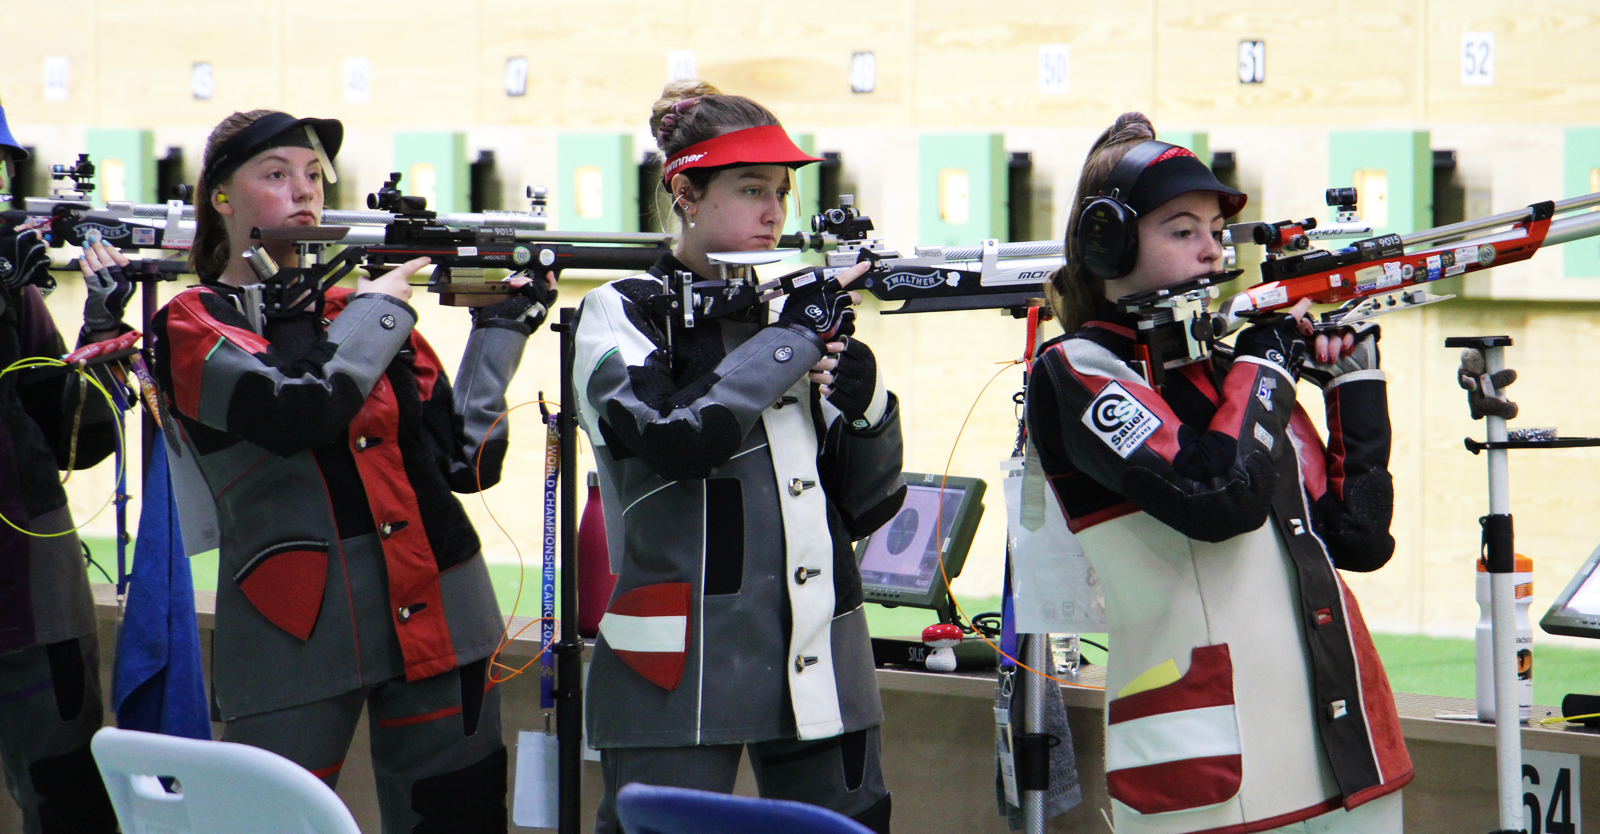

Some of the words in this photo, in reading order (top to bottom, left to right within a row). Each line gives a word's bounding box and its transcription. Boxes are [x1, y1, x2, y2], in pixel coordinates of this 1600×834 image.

[849, 54, 876, 90] 49
[1044, 53, 1065, 86] 50
[1239, 41, 1264, 83] 51
[1464, 41, 1490, 76] 52
[192, 64, 213, 98] 45
[666, 154, 704, 174] winner
[494, 228, 514, 236] 9015
[1379, 235, 1400, 247] 9015
[891, 275, 935, 286] WALTHER
[136, 369, 153, 390] ISSF
[1111, 411, 1144, 446] Sauer
[1125, 425, 1152, 449] Germany
[546, 445, 558, 488] WORLD
[544, 491, 556, 581] CHAMPIONSHIP
[543, 623, 554, 653] 2022
[1521, 764, 1576, 834] 64
